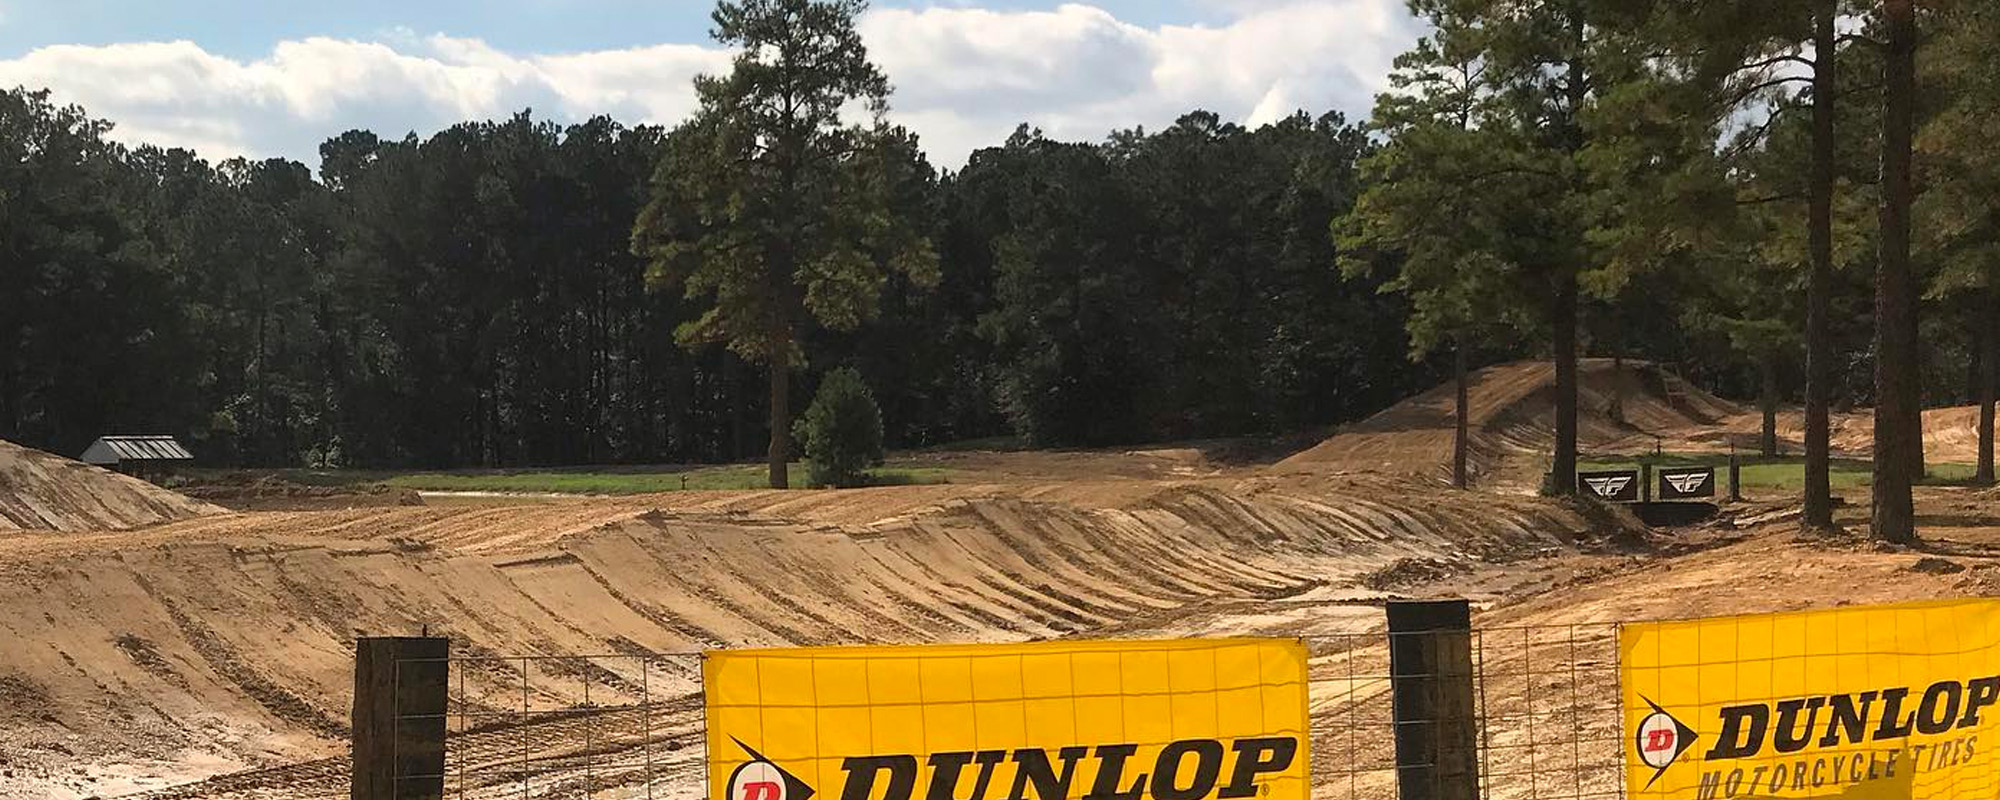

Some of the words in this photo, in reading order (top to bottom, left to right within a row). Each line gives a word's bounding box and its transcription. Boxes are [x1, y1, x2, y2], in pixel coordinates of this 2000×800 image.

[1645, 729, 1674, 752] D
[1704, 676, 2000, 761] DUNLOP
[840, 737, 1298, 800] DUNLOP
[1697, 748, 1900, 800] MOTORCYCLE
[1912, 735, 1977, 773] TIRES
